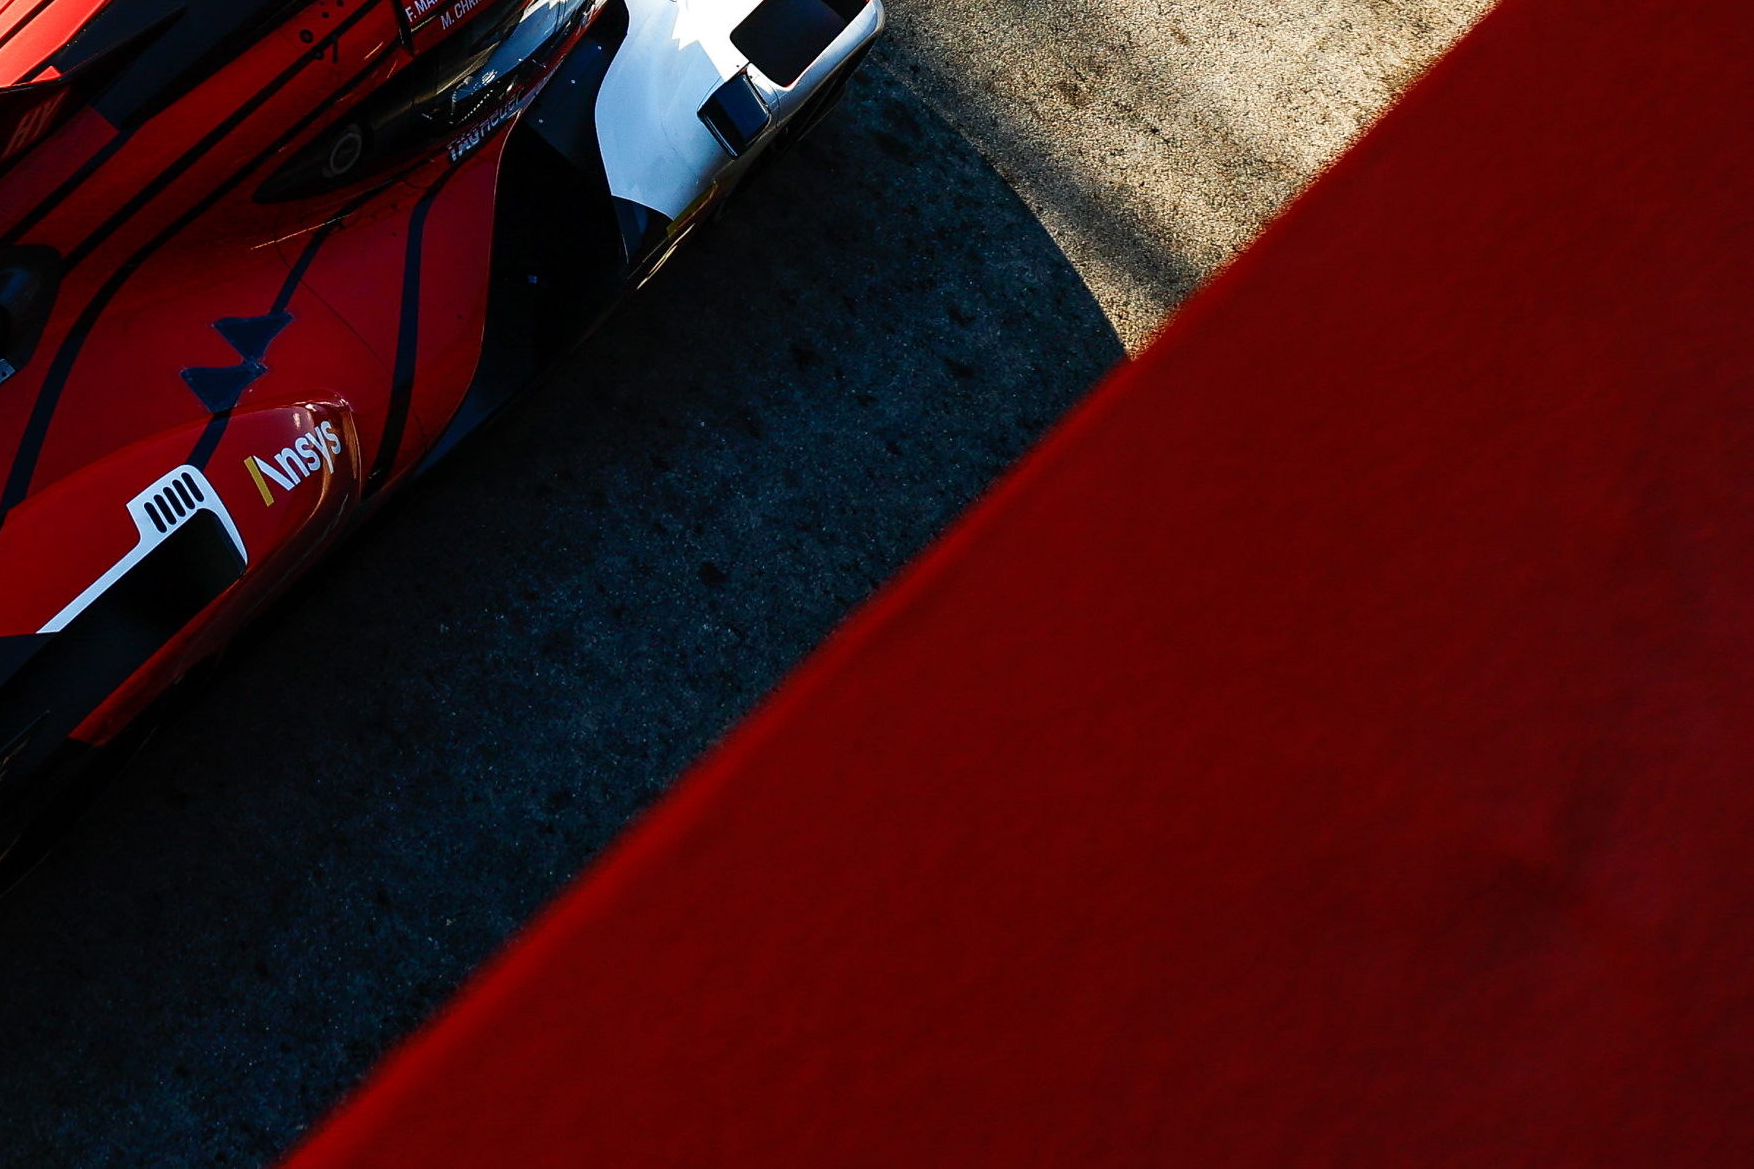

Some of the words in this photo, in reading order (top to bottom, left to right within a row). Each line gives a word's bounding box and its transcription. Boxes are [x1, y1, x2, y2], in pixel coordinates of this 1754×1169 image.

[405, 7, 417, 23] F.
[440, 10, 455, 30] M.
[244, 420, 342, 507] Ansys
